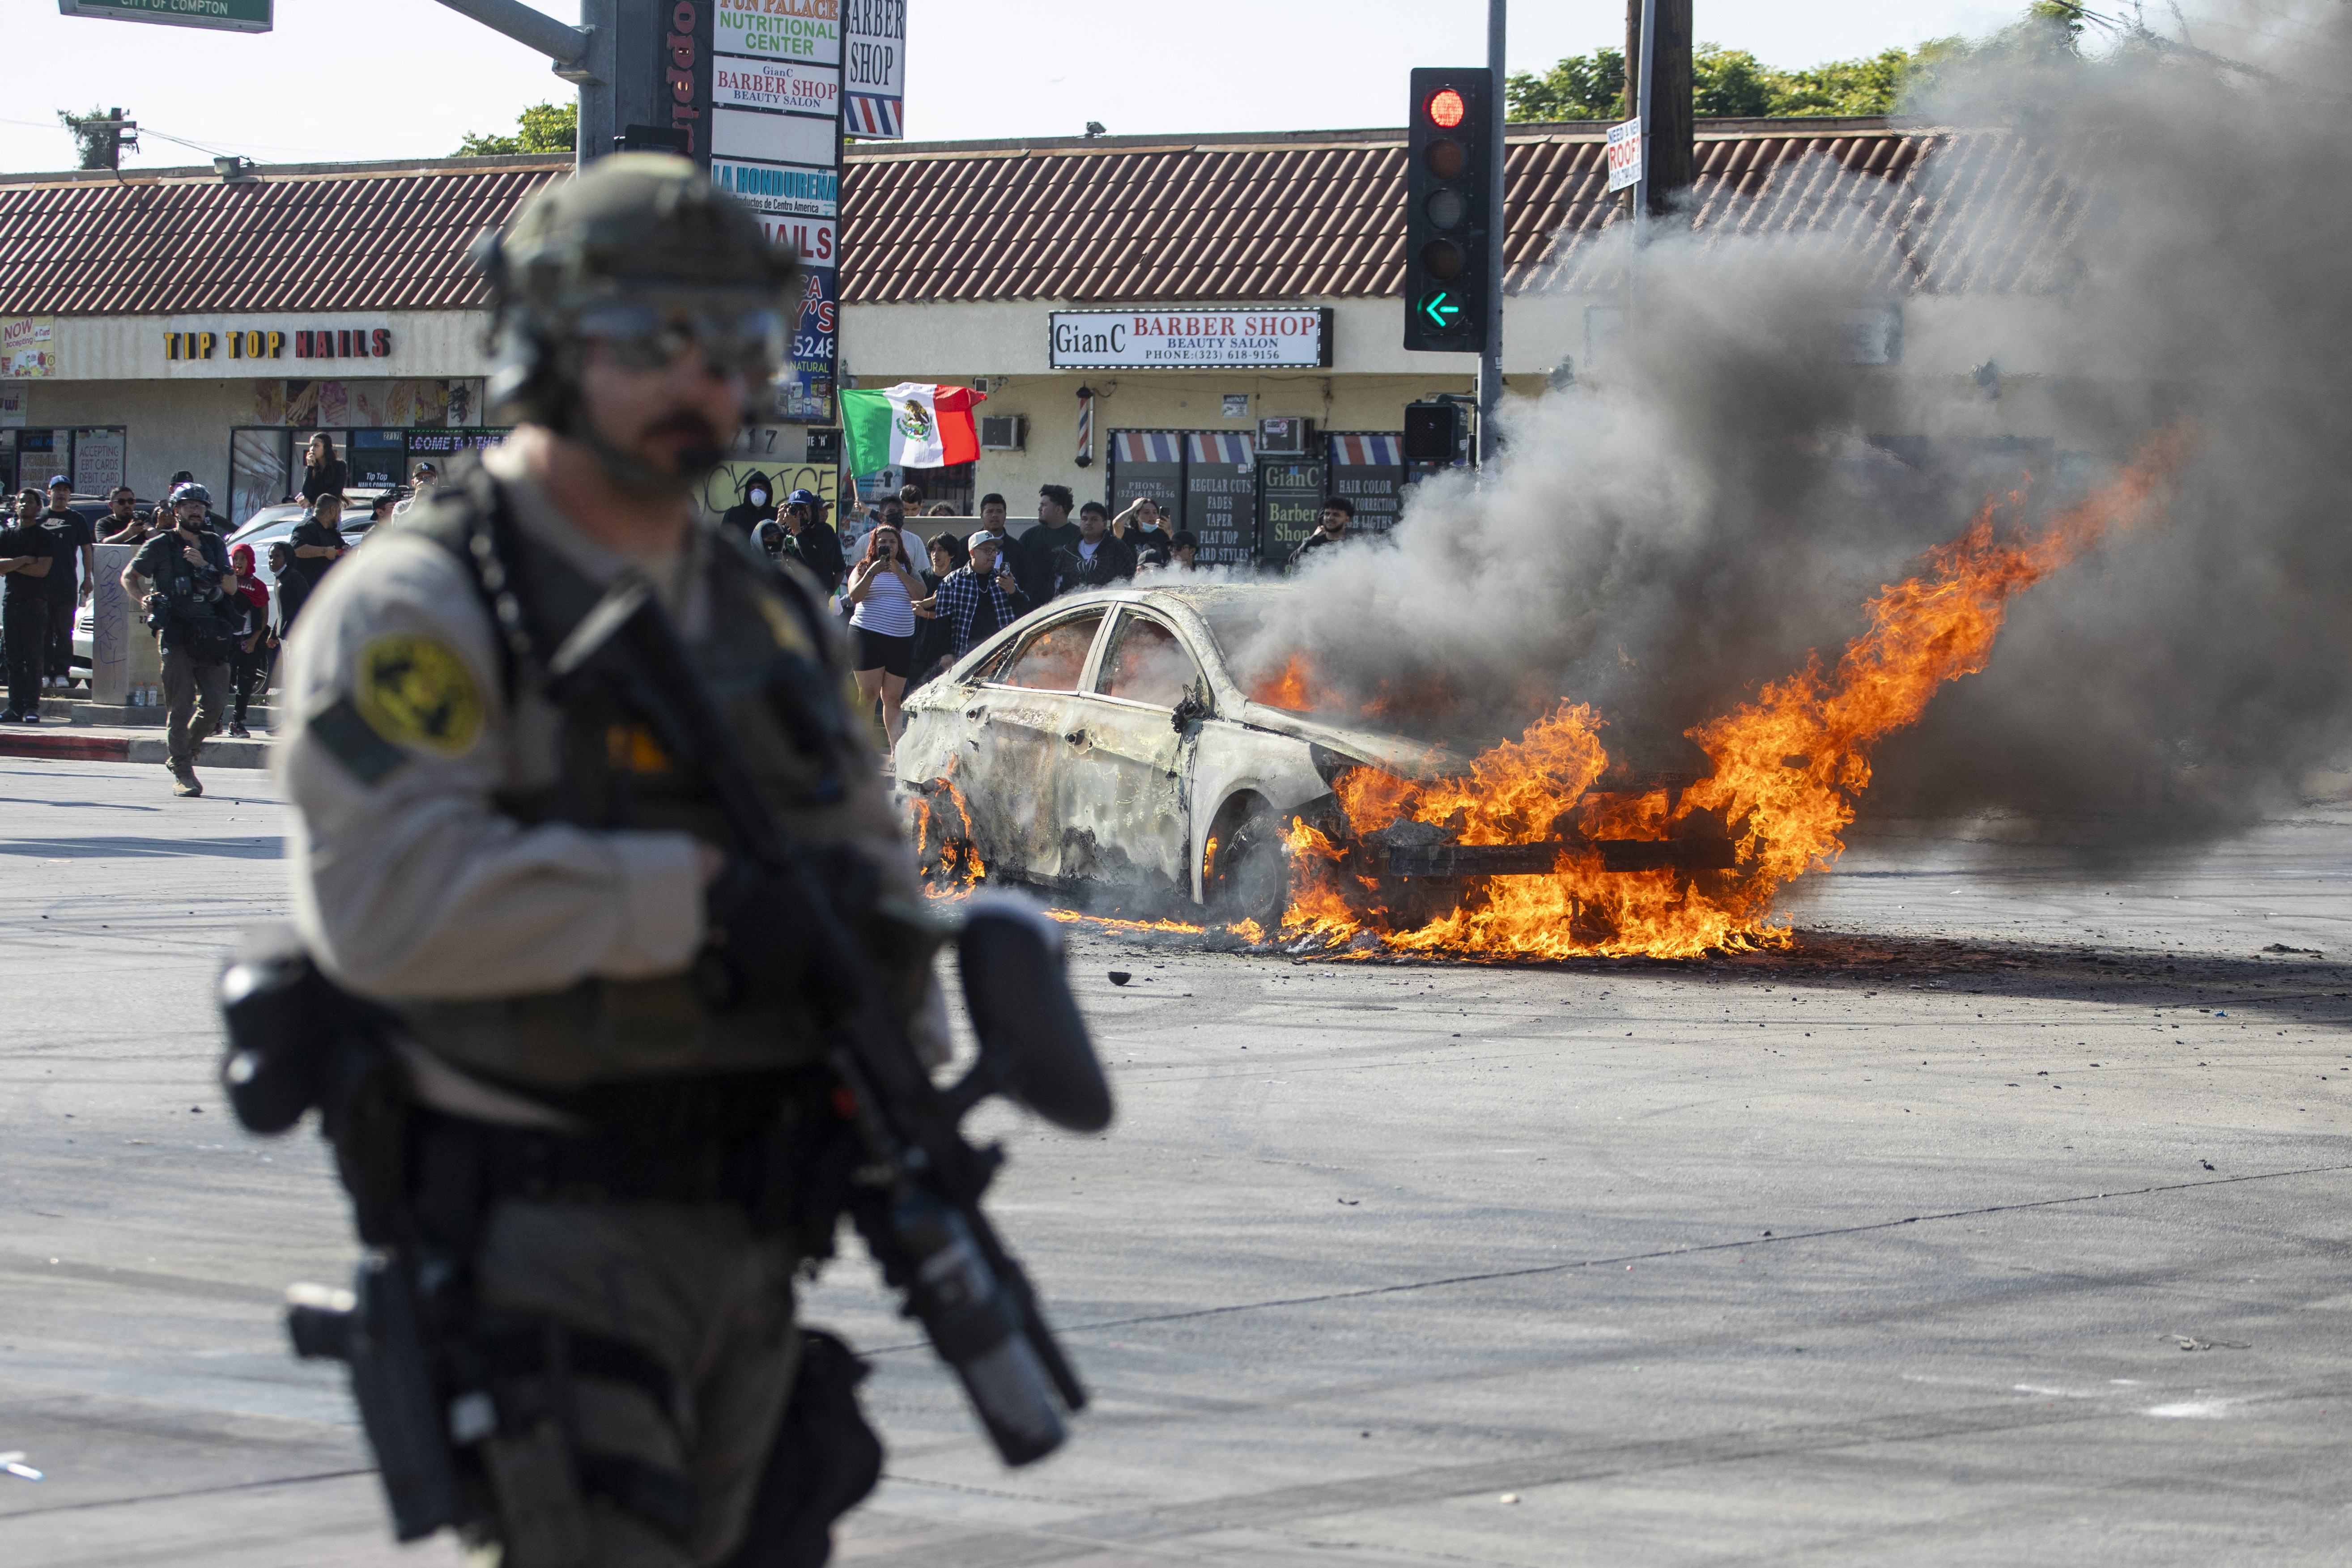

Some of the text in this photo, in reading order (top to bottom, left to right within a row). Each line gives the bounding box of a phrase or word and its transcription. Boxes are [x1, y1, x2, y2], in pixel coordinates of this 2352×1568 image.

[152, 0, 166, 8] OF
[170, 0, 228, 15] COMPTON
[764, 0, 838, 21] PALACE
[720, 11, 838, 40] NUTRITIONAL
[745, 33, 814, 55] CENTER
[851, 42, 893, 85] SHOP
[763, 66, 793, 77] GianC
[718, 71, 838, 100] BARBER SHOP
[734, 90, 821, 108] BEAUTY SALON
[1609, 135, 1639, 171] ROOF?
[736, 167, 837, 201] HONDUREÑA
[764, 198, 772, 209] de
[773, 199, 792, 211] Centro
[794, 202, 819, 213] America
[756, 222, 832, 259] NAILS
[4, 318, 33, 341] NOW
[1055, 316, 1315, 353] GianC BARBER SHOP
[6, 337, 33, 348] accepting
[164, 328, 391, 359] TIP TOP NAILS
[1167, 338, 1278, 348] BEAUTY SALON
[1228, 350, 1280, 359] 618-9156
[790, 361, 829, 373] NATURAL
[476, 436, 499, 450] THE
[79, 446, 119, 457] ACCEPTING
[24, 455, 66, 467] FORMULA
[81, 459, 119, 470] EBT CARDS
[79, 472, 120, 484] DEBIT CARD
[366, 472, 388, 481] Tip Top
[1266, 467, 1319, 487] GianC
[81, 485, 100, 494] CREDIT
[1129, 482, 1164, 490] PHONE:
[1191, 479, 1251, 493] REGULAR CUTS
[1339, 480, 1391, 493] HAIR COLOR
[1118, 490, 1175, 498] (323)618-9156
[1208, 496, 1233, 510] FADES
[1269, 503, 1317, 522] Barber
[45, 518, 65, 526] NIKE
[1206, 514, 1233, 527] TAPER
[1200, 530, 1238, 544] FLAT TOP
[1275, 522, 1310, 542] Shop
[1219, 548, 1249, 562] STYLES
